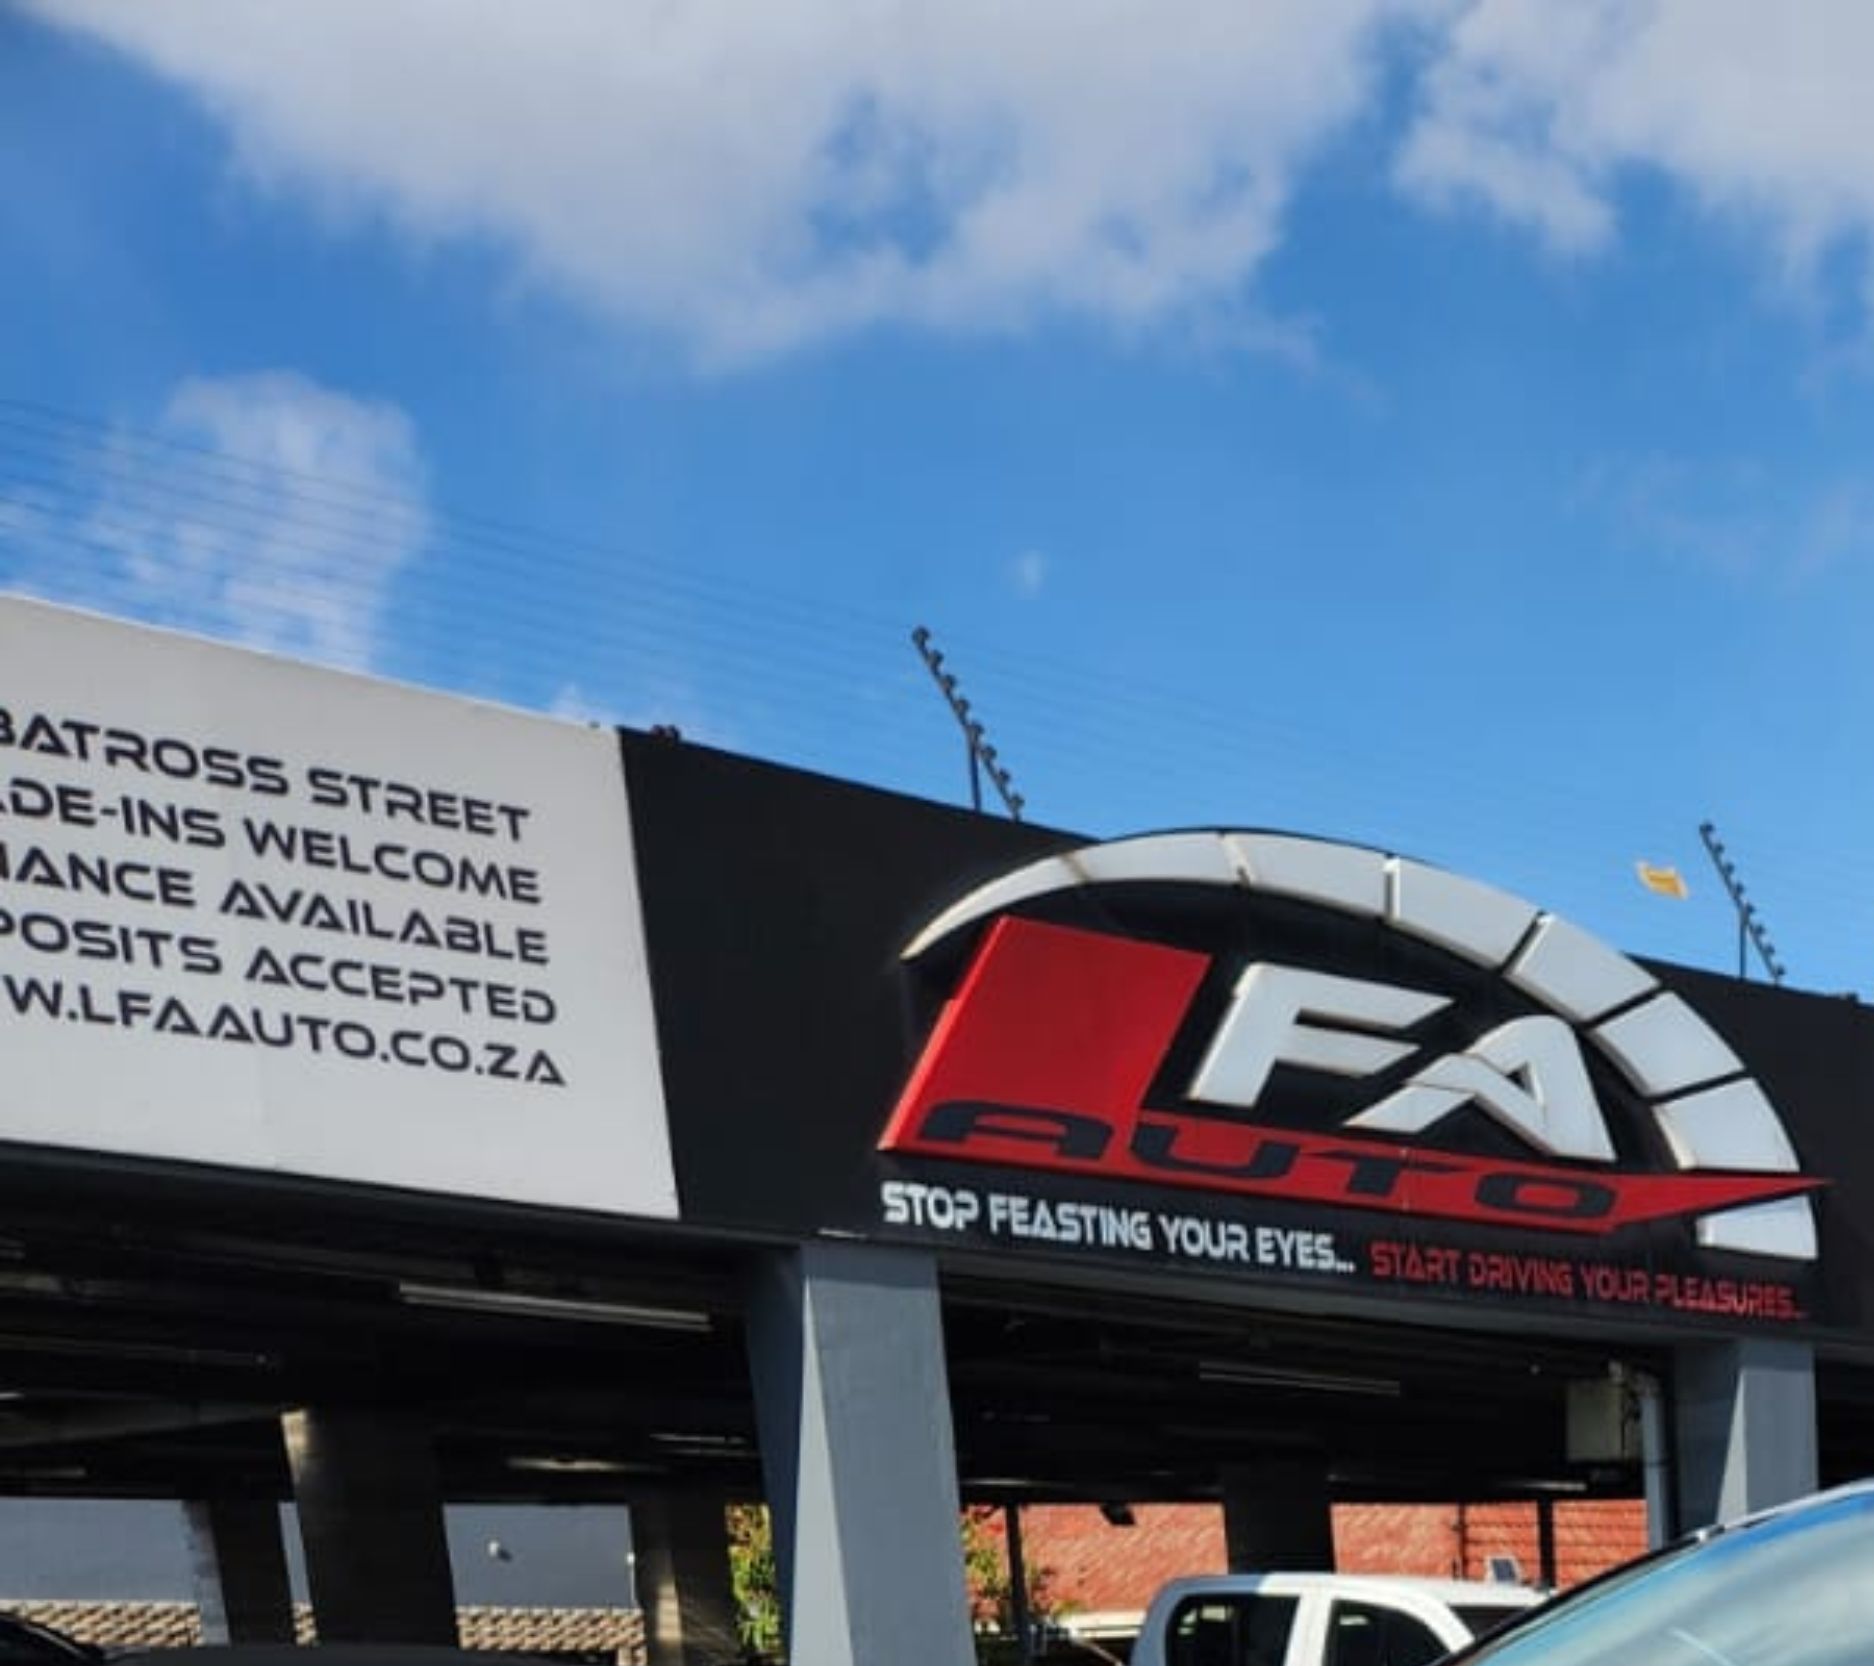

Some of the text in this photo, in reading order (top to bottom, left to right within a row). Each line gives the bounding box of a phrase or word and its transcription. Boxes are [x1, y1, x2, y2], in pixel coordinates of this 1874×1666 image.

[308, 767, 530, 842] STREET
[243, 816, 542, 904] WELCOME
[219, 879, 550, 965] AVAILABLE
[245, 946, 558, 1023] ACCEPTED
[916, 1099, 1620, 1222] AUTO
[880, 1181, 980, 1230] STOP
[987, 1193, 1154, 1251] FEASTING
[1158, 1213, 1249, 1262] YOUR
[1255, 1226, 1356, 1274] EYES...
[1368, 1240, 1461, 1283] START
[1467, 1252, 1575, 1297] DRIVING
[1580, 1263, 1650, 1304] YOUR
